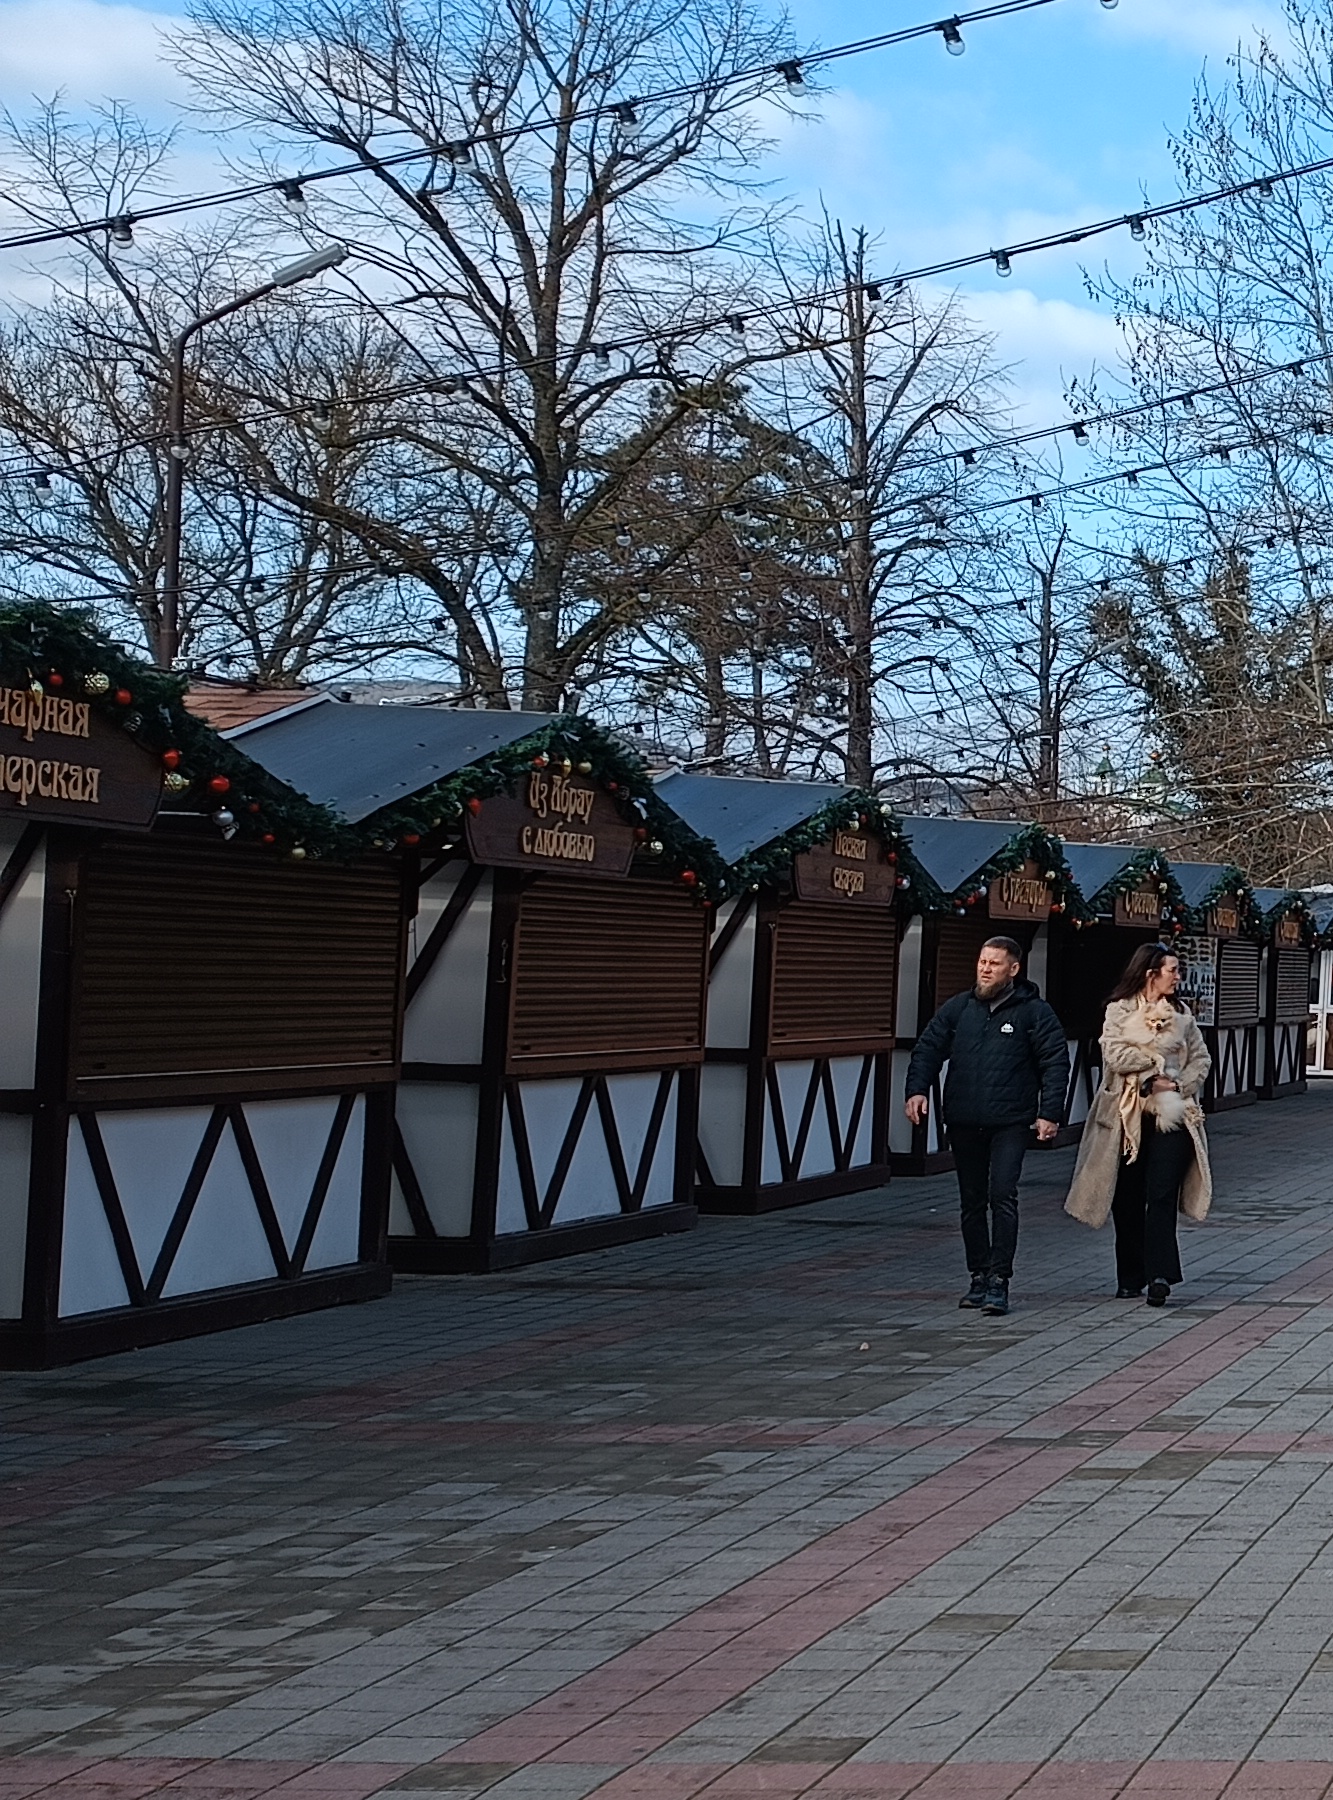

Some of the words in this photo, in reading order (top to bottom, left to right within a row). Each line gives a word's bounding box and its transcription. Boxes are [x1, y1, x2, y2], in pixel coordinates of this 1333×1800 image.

[0, 754, 101, 806] ерская
[529, 771, 549, 818] Из
[550, 775, 595, 825] Абрау
